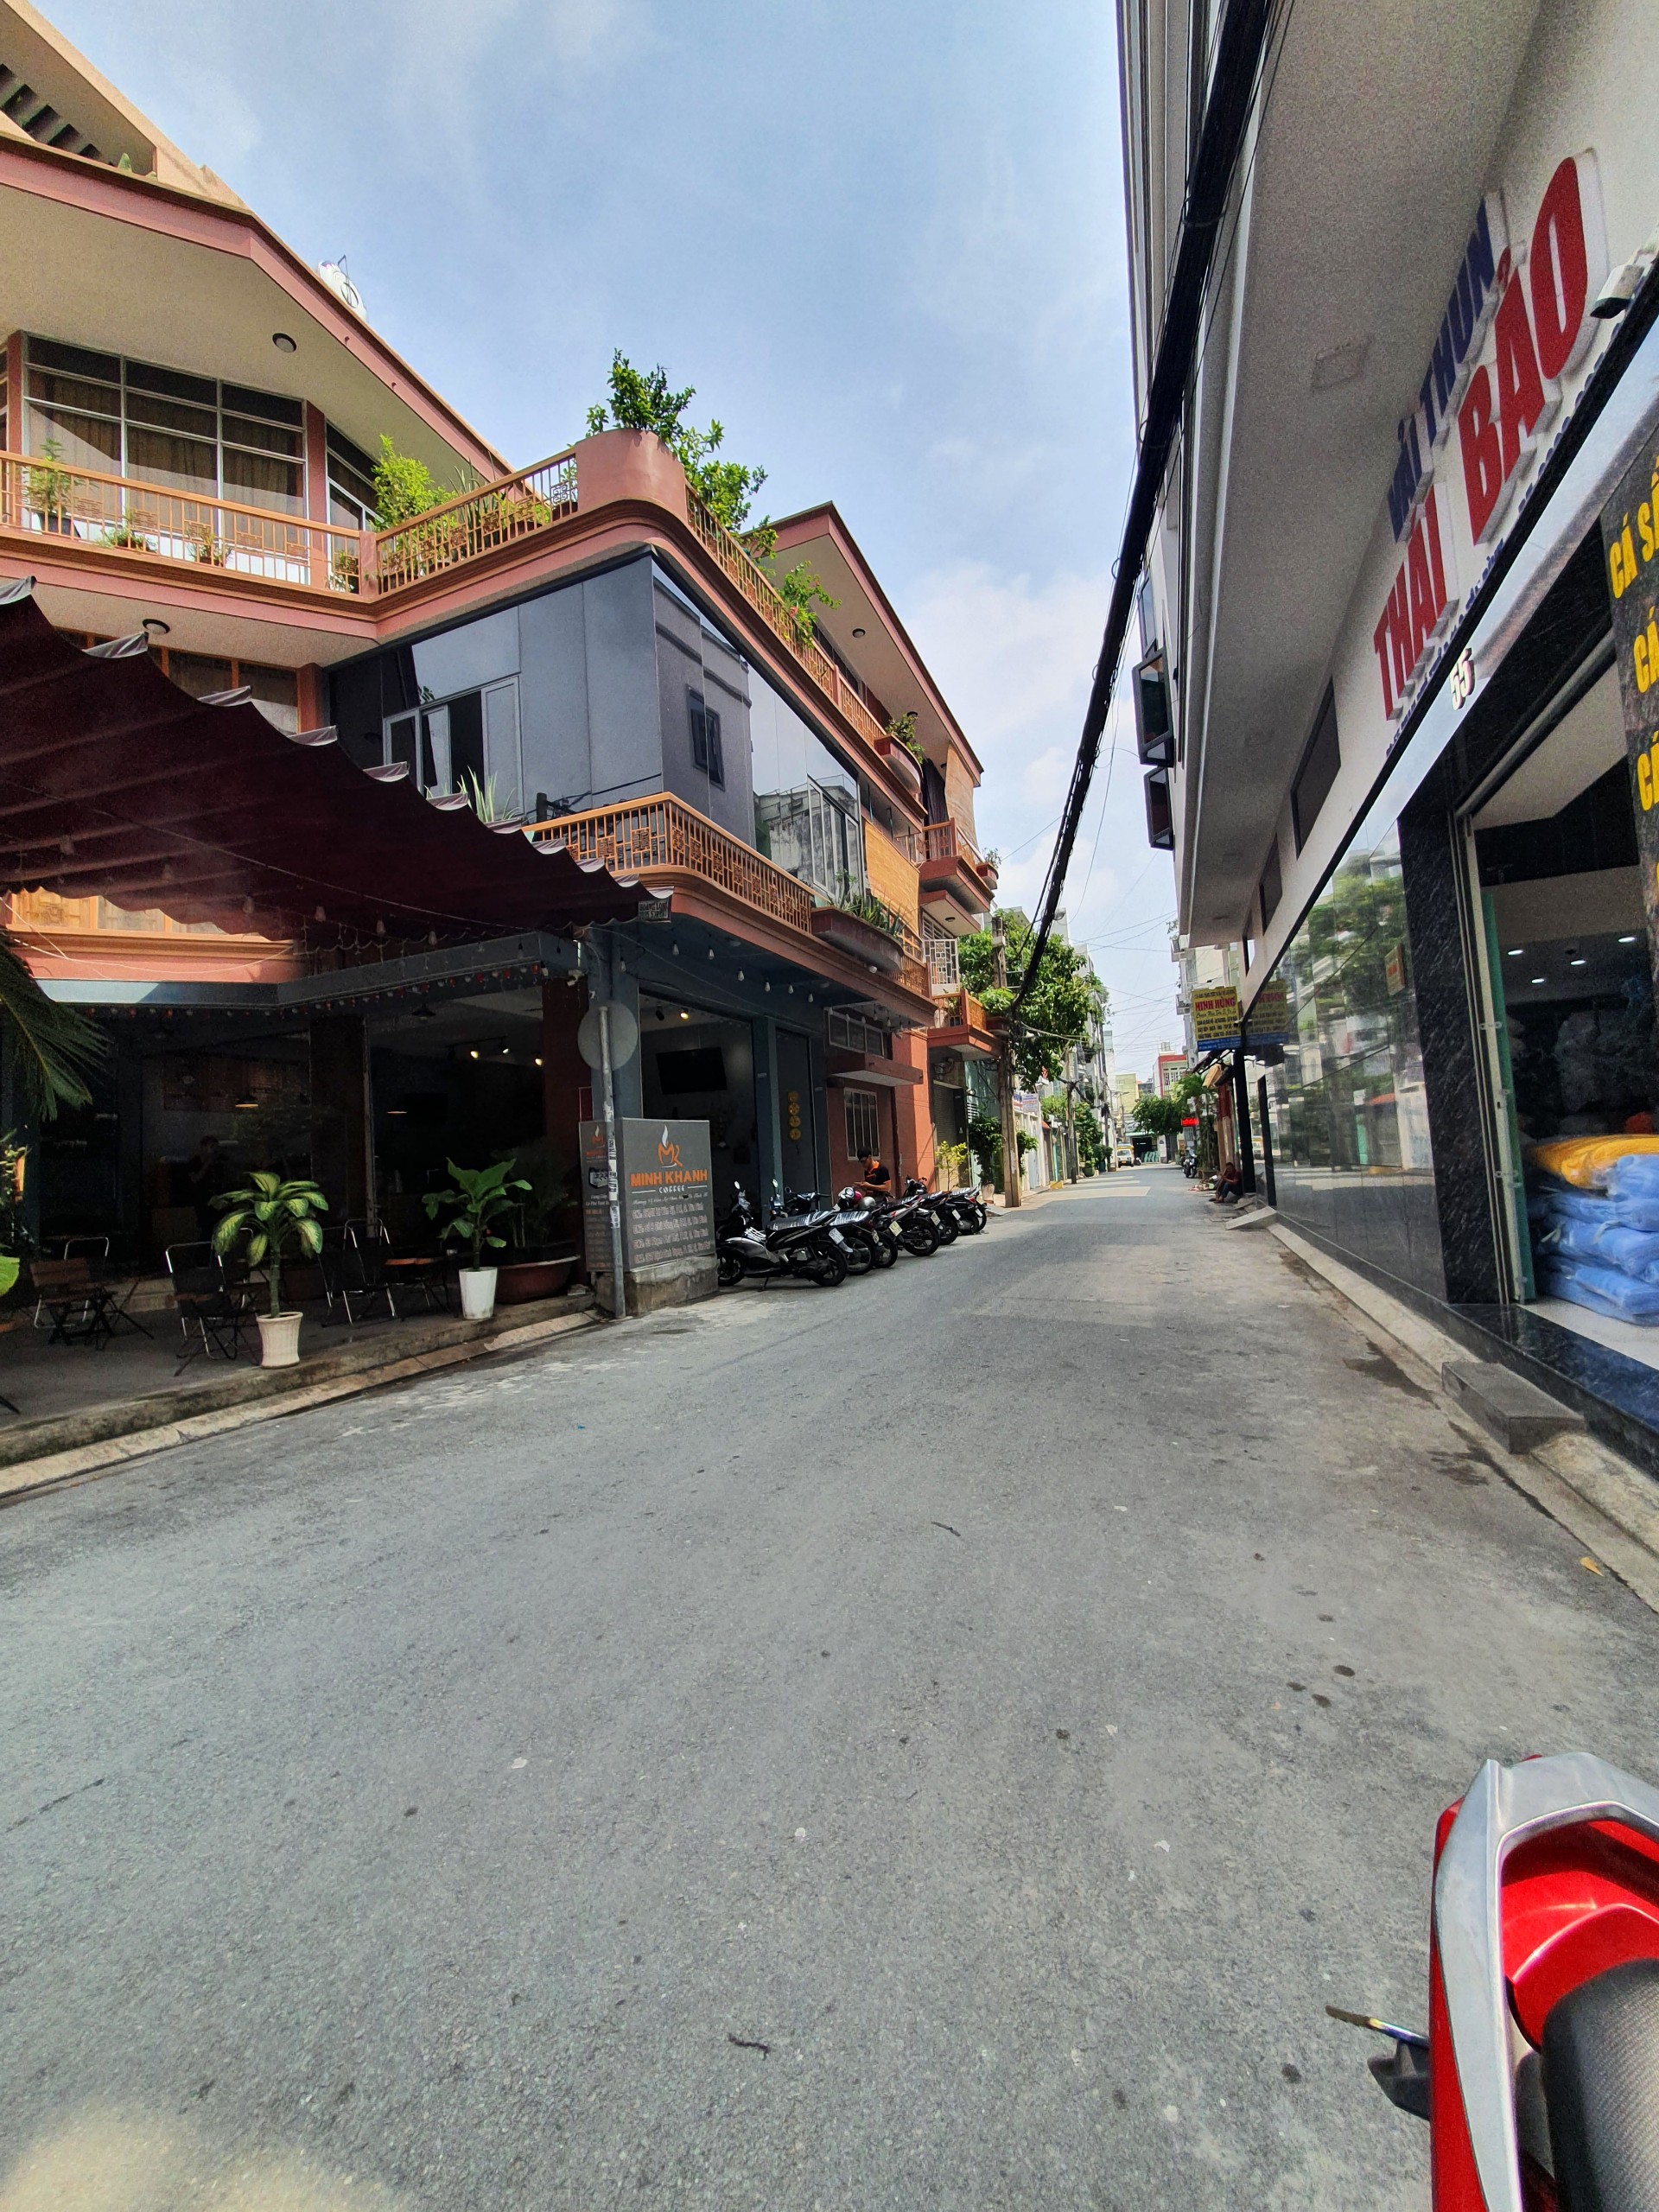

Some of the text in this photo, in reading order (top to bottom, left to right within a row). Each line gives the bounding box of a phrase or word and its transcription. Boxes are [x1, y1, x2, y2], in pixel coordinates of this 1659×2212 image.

[1420, 195, 1495, 448] THUN
[1374, 484, 1447, 721] THÁI
[1457, 156, 1588, 546] BẢO
[1610, 512, 1638, 599] CÁ
[1449, 648, 1476, 711] 55
[1633, 606, 1659, 693] CÁ
[630, 1172, 663, 1187] MINH
[664, 1169, 708, 1185] KHANH
[658, 1185, 685, 1193] COFFEE
